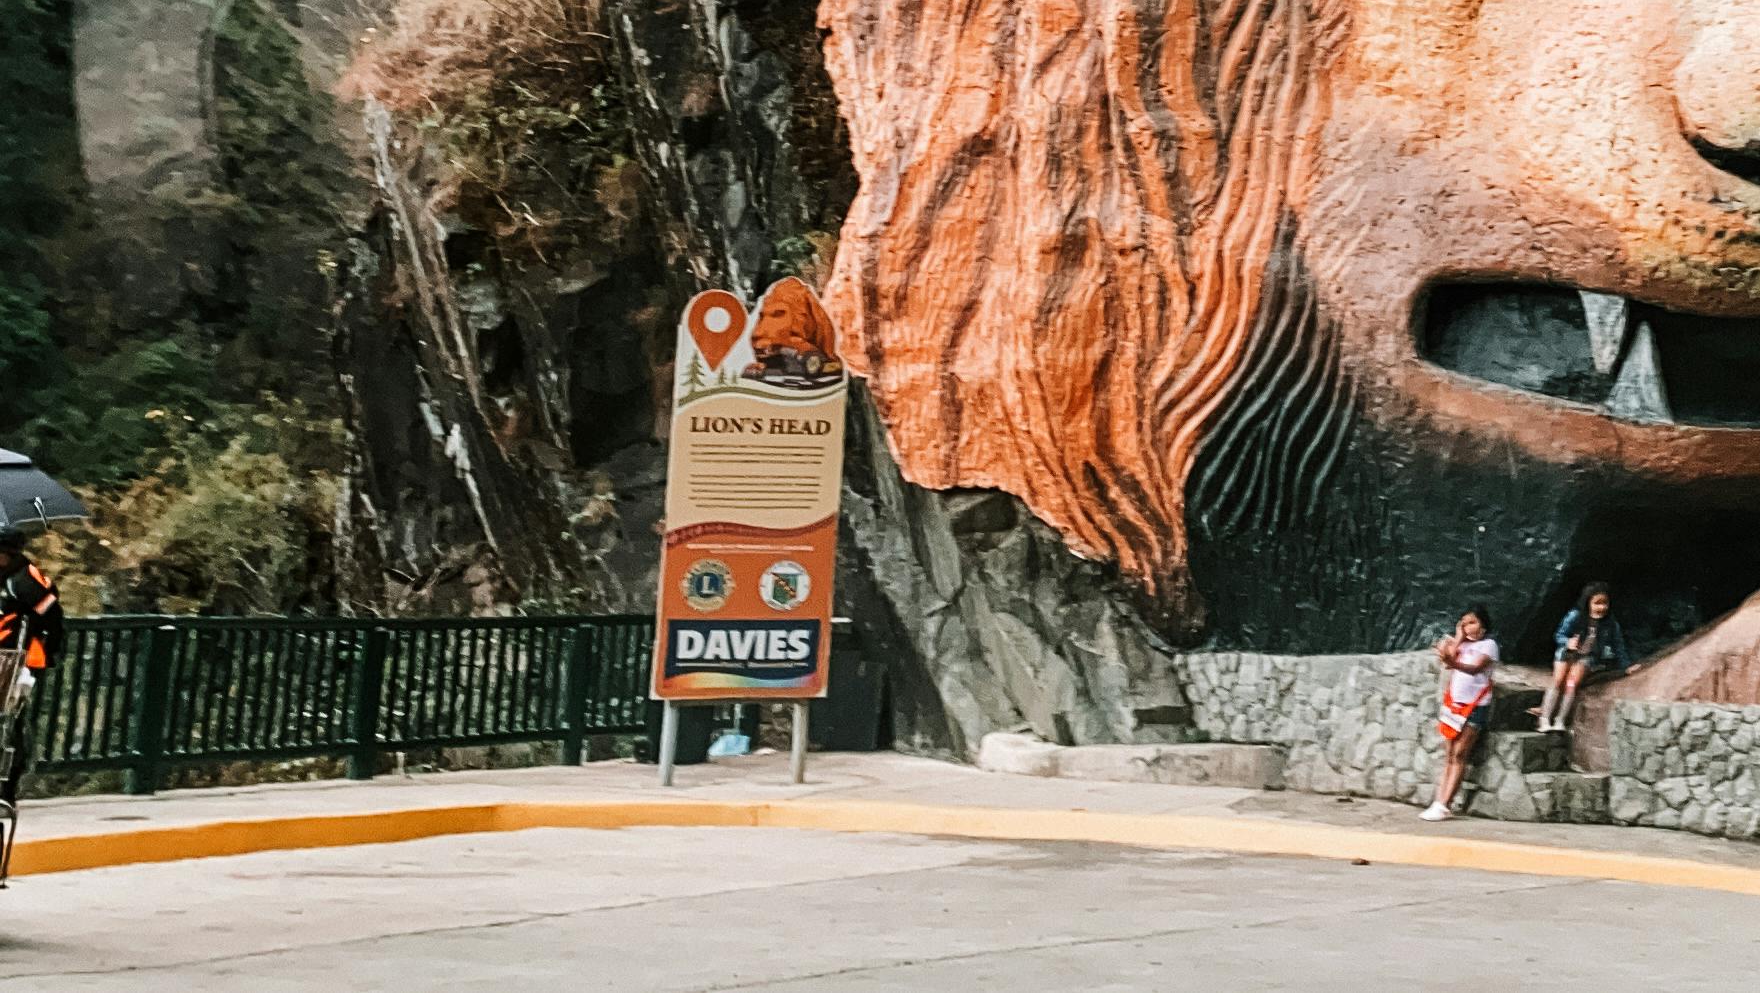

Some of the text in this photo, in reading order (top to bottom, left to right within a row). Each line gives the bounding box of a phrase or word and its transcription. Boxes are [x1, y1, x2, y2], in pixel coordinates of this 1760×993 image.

[689, 416, 832, 436] LION'S HEAD
[701, 575, 715, 595] L
[676, 629, 811, 661] DAVIES
